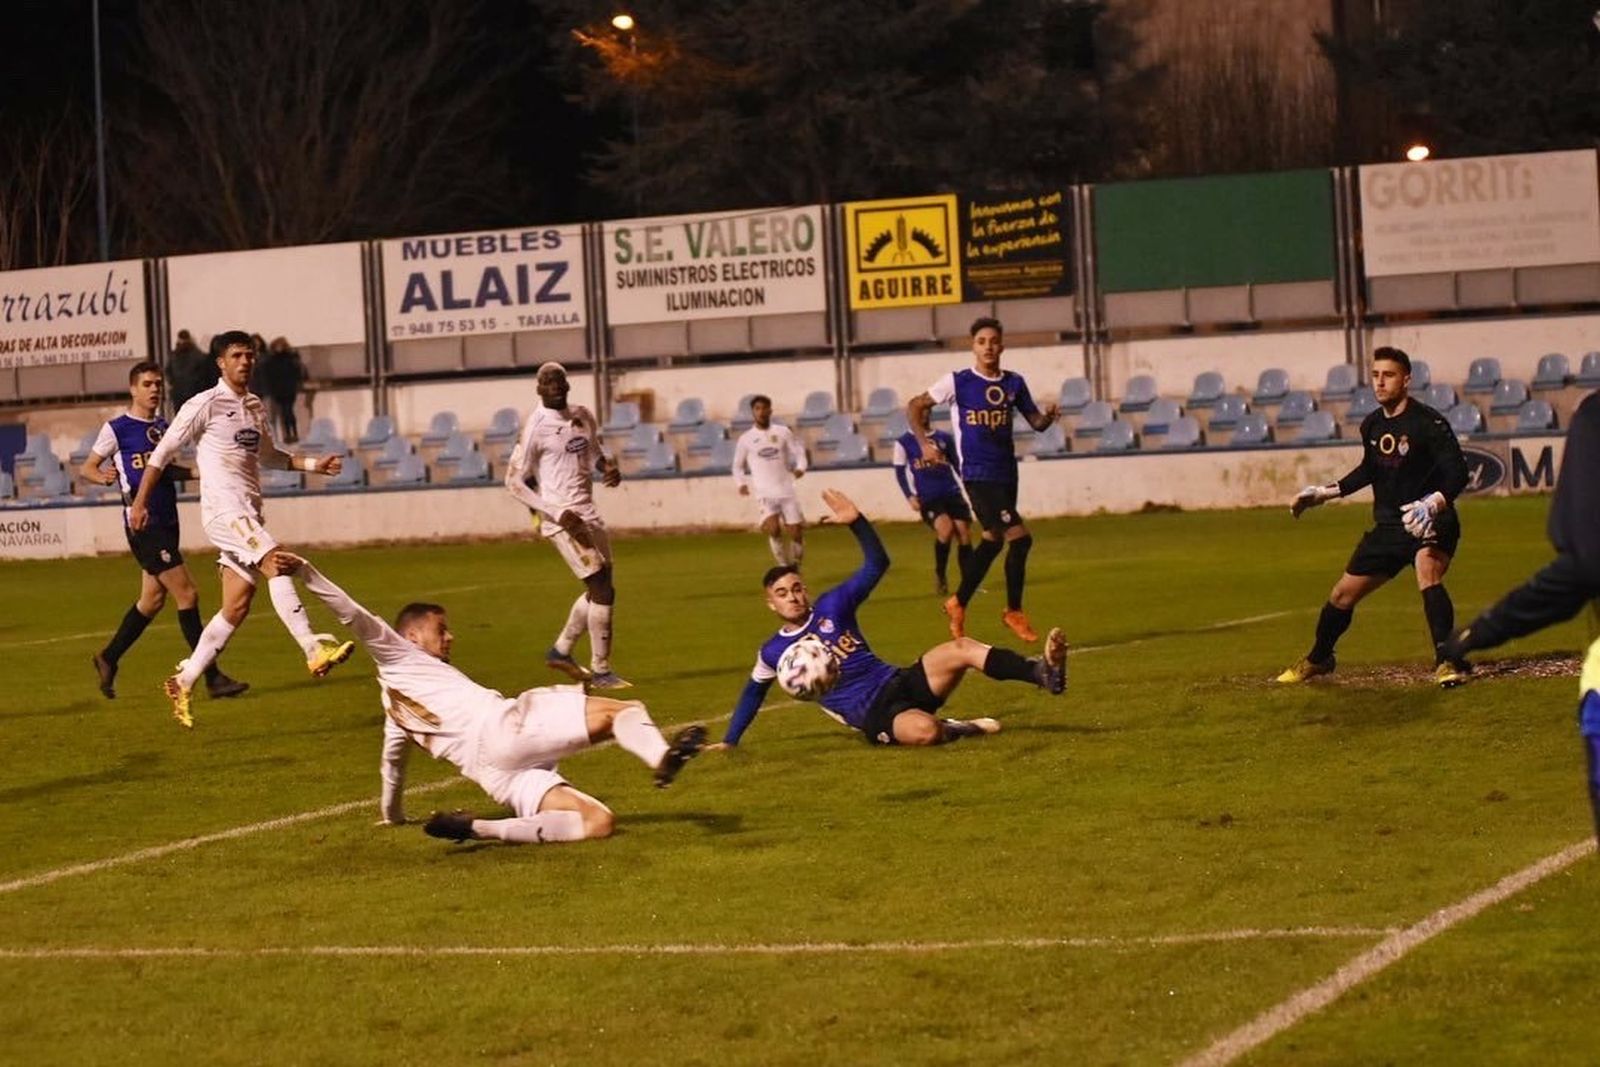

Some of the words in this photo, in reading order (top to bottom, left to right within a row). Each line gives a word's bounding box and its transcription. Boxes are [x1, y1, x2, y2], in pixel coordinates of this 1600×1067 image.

[1038, 209, 1059, 226] de
[402, 230, 562, 261] MUEBLES
[684, 213, 815, 259] VALERO
[616, 264, 717, 289] SUMINISTROS
[722, 257, 815, 282] ELECTRICOS
[400, 261, 571, 314] ALAIZ
[666, 287, 765, 312] ILUMINACION
[859, 274, 953, 301] AGUIRRE
[409, 321, 433, 335] 948
[438, 320, 454, 333] 75
[459, 319, 475, 332] 53
[481, 317, 496, 330] 15
[517, 313, 580, 328] TAFALLA
[19, 338, 31, 352] DE
[34, 335, 58, 351] ALTA
[61, 331, 127, 349] DECORACION
[965, 404, 1008, 431] anpi
